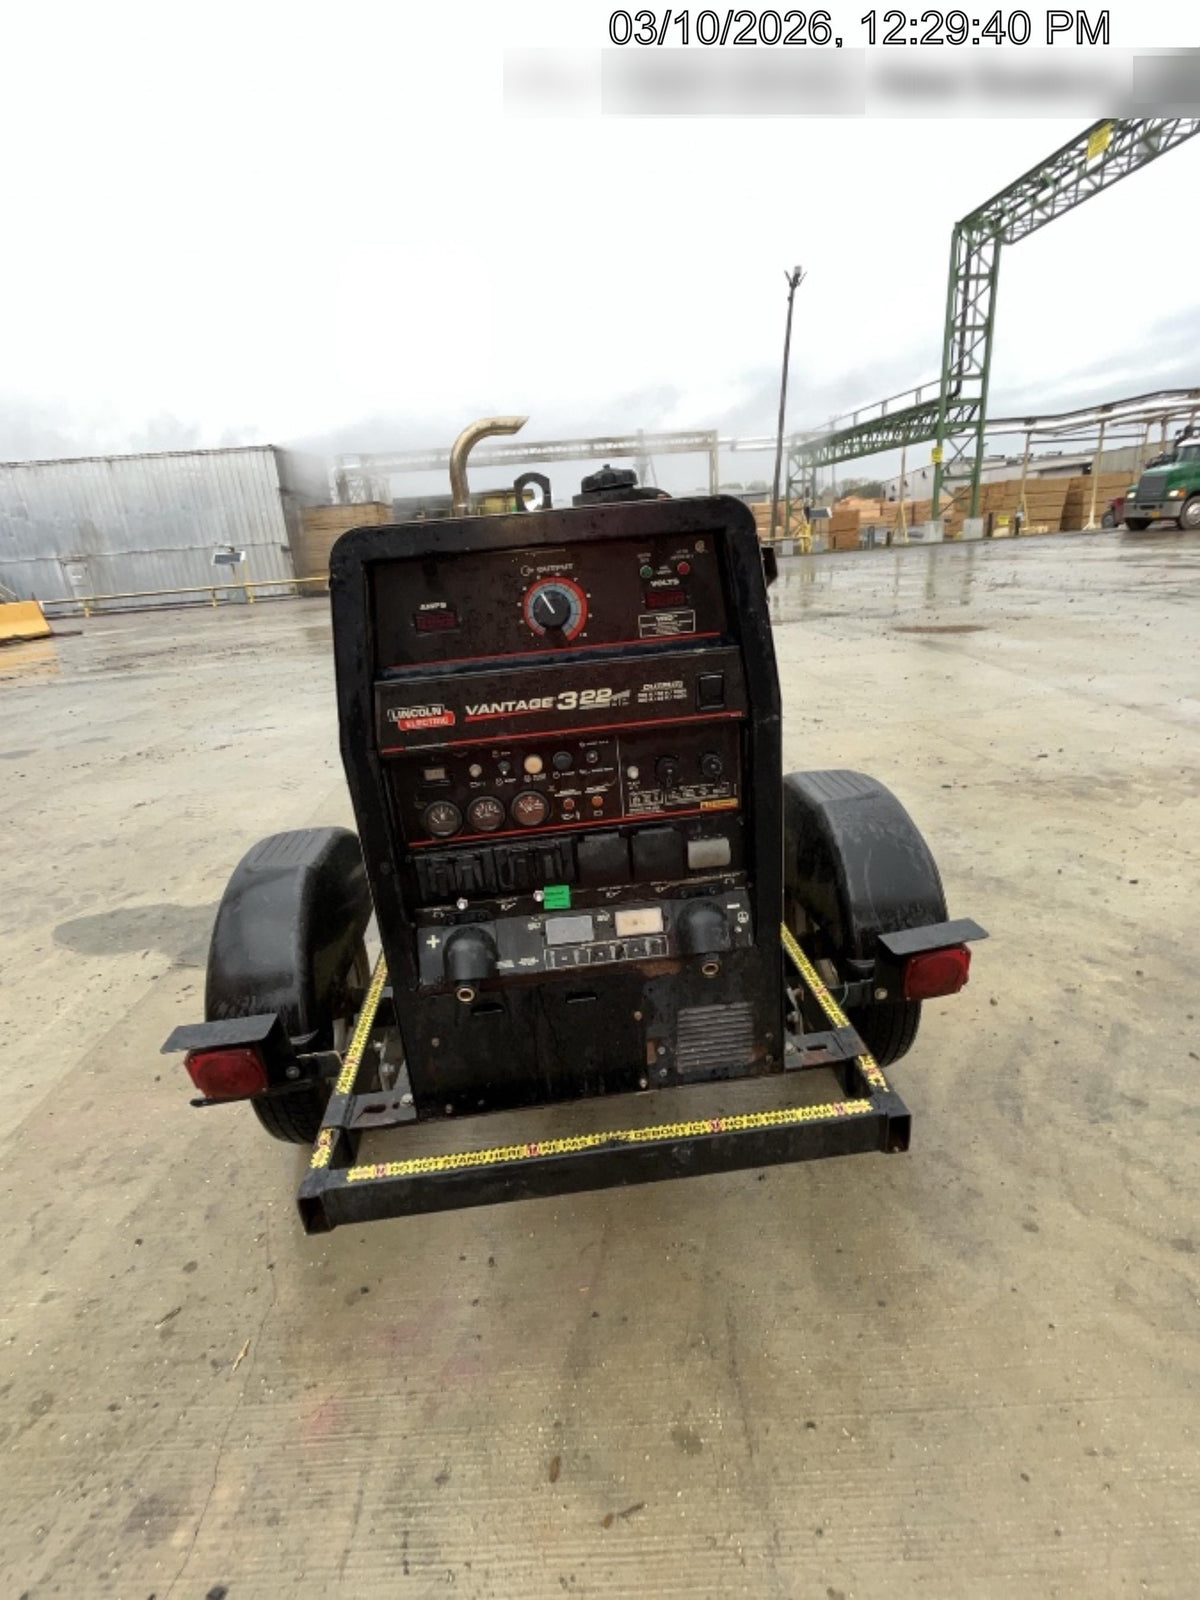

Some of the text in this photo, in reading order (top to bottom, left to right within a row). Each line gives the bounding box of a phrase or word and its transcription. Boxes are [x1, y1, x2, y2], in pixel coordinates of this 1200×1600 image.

[536, 563, 574, 573] OUTPUT
[650, 577, 680, 588] VOLTS
[419, 602, 447, 611] AMPS
[465, 696, 554, 717] VANTAGE
[557, 687, 612, 710] 322
[391, 706, 442, 721] LINCOLN
